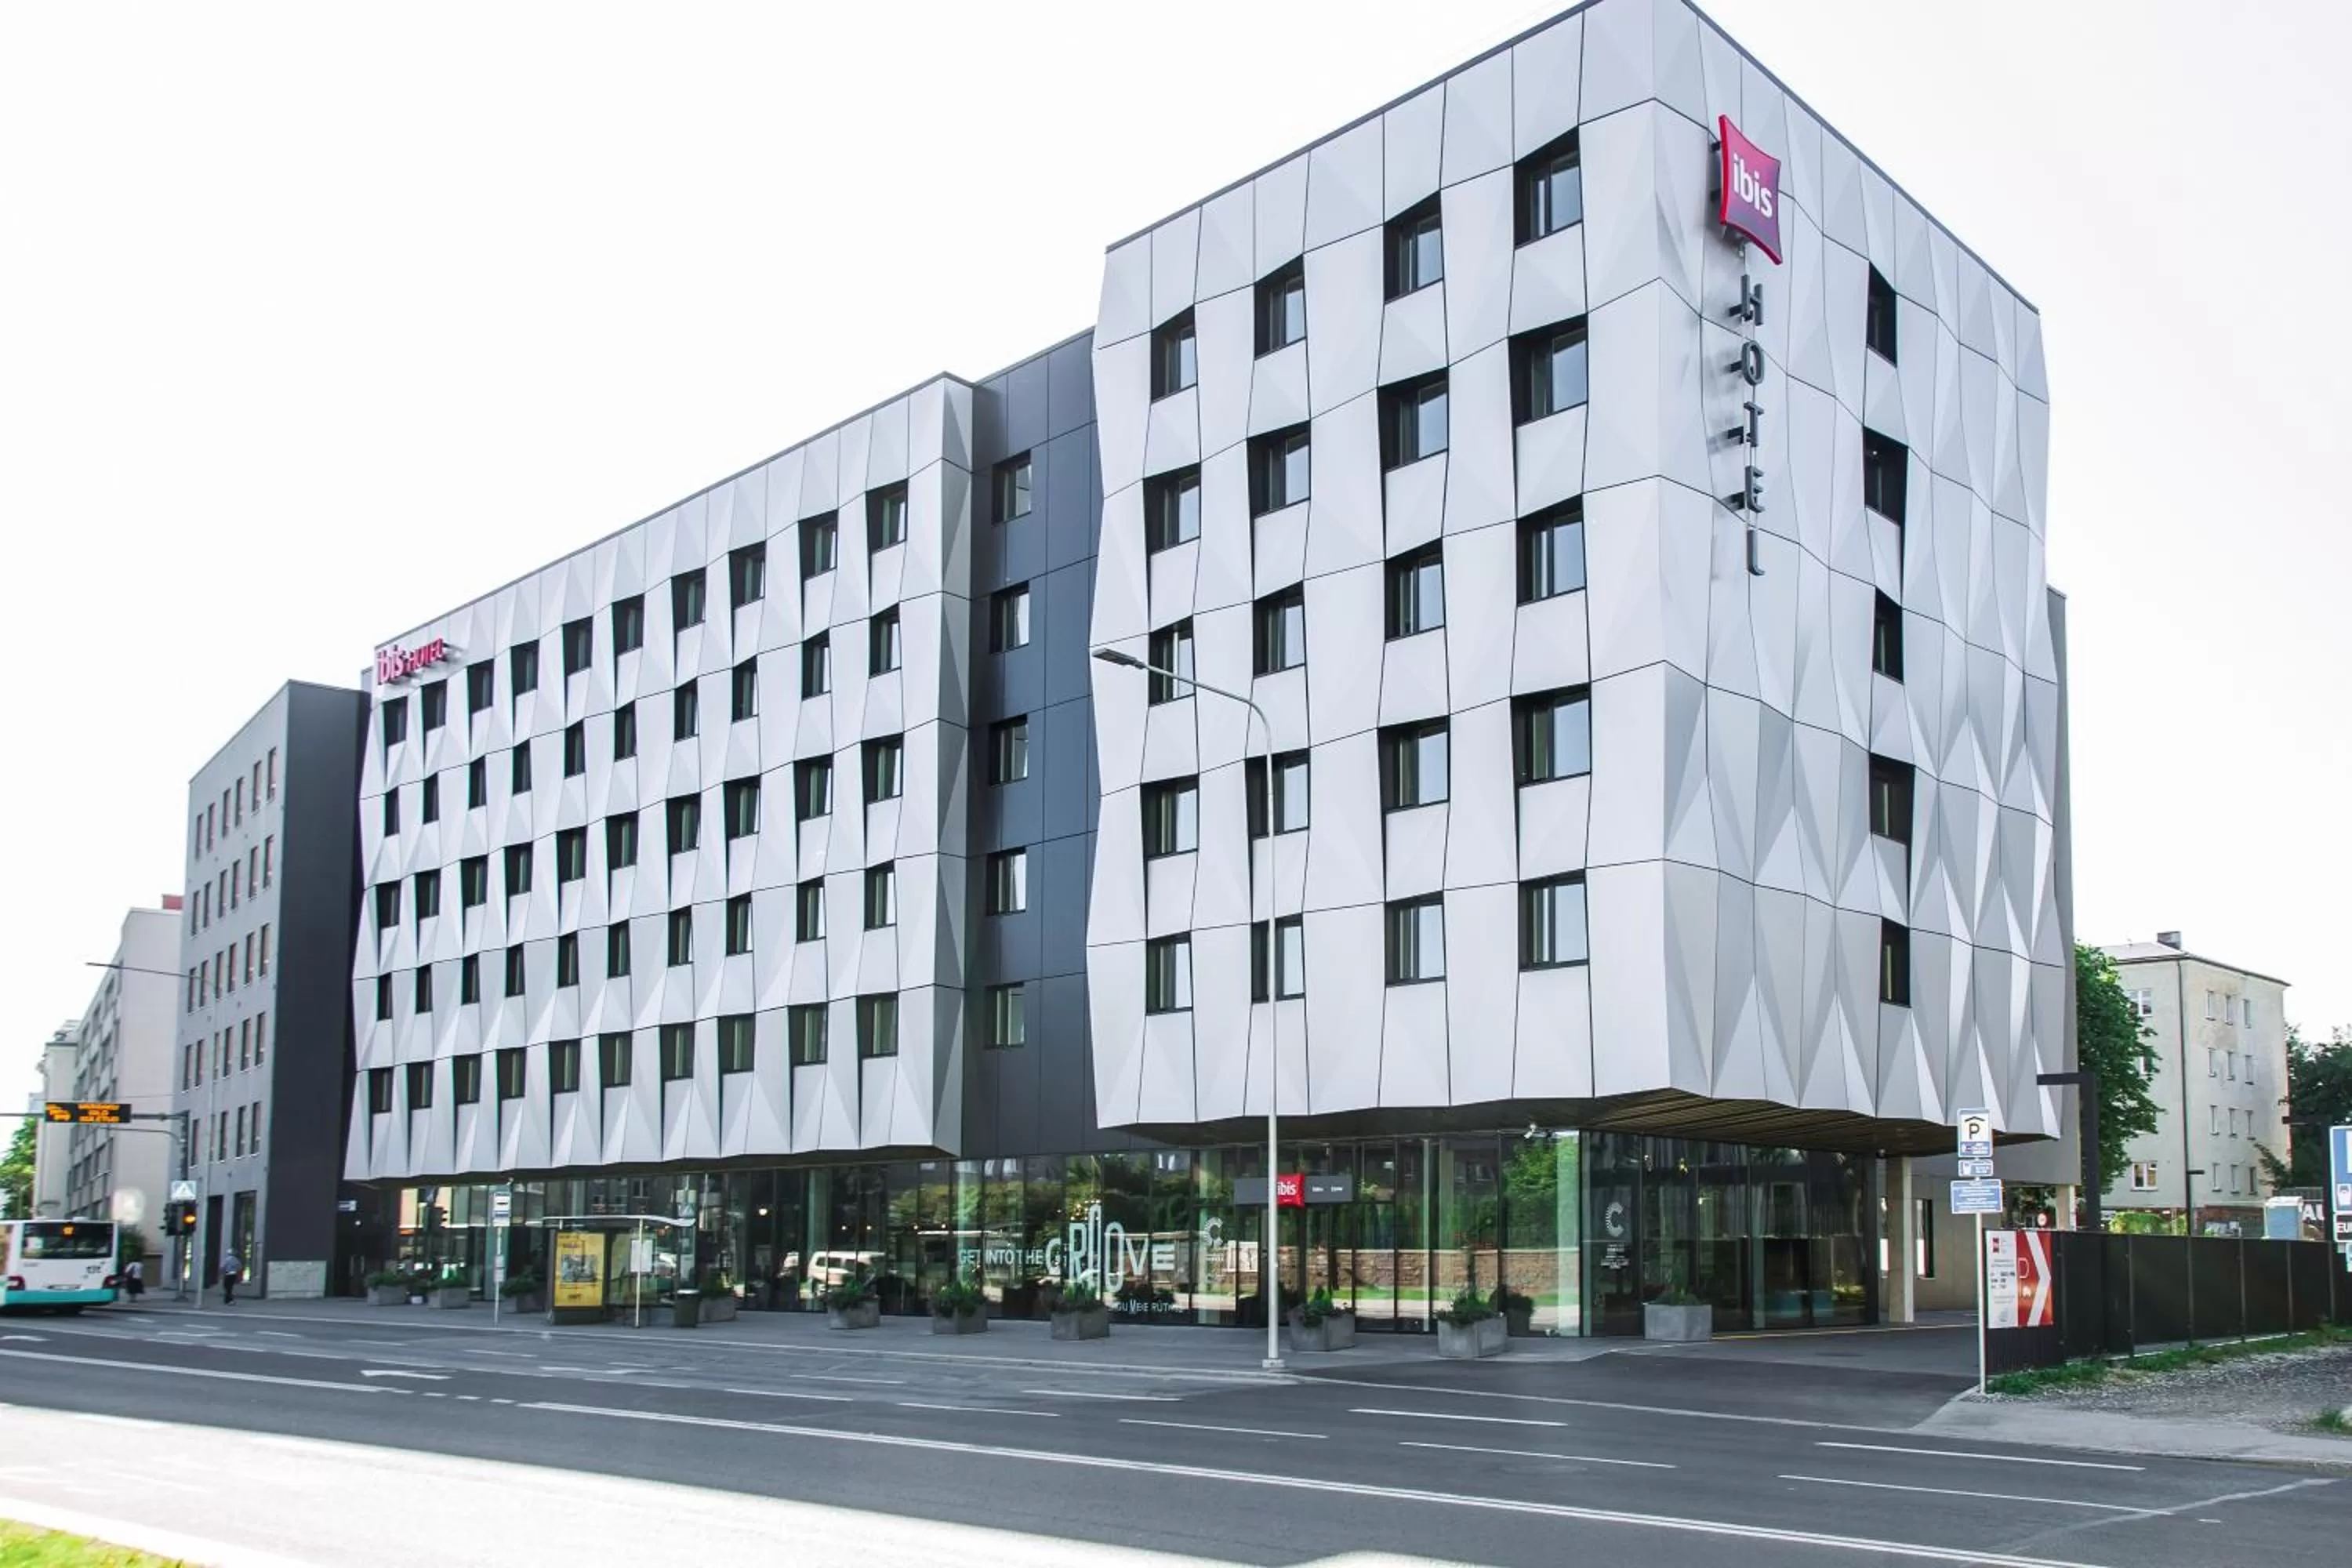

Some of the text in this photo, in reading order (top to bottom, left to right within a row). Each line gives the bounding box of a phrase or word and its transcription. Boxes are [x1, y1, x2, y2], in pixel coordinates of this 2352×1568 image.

[1733, 153, 1773, 218] ibis
[1740, 274, 1765, 576] HOTEL
[377, 644, 407, 685] ibis
[1969, 1123, 1980, 1139] P
[1277, 1181, 1297, 1196] ibis
[2337, 1222, 2352, 1233] EU
[959, 1249, 981, 1264] GET
[985, 1249, 1014, 1265] INTO
[1018, 1249, 1044, 1264] THE
